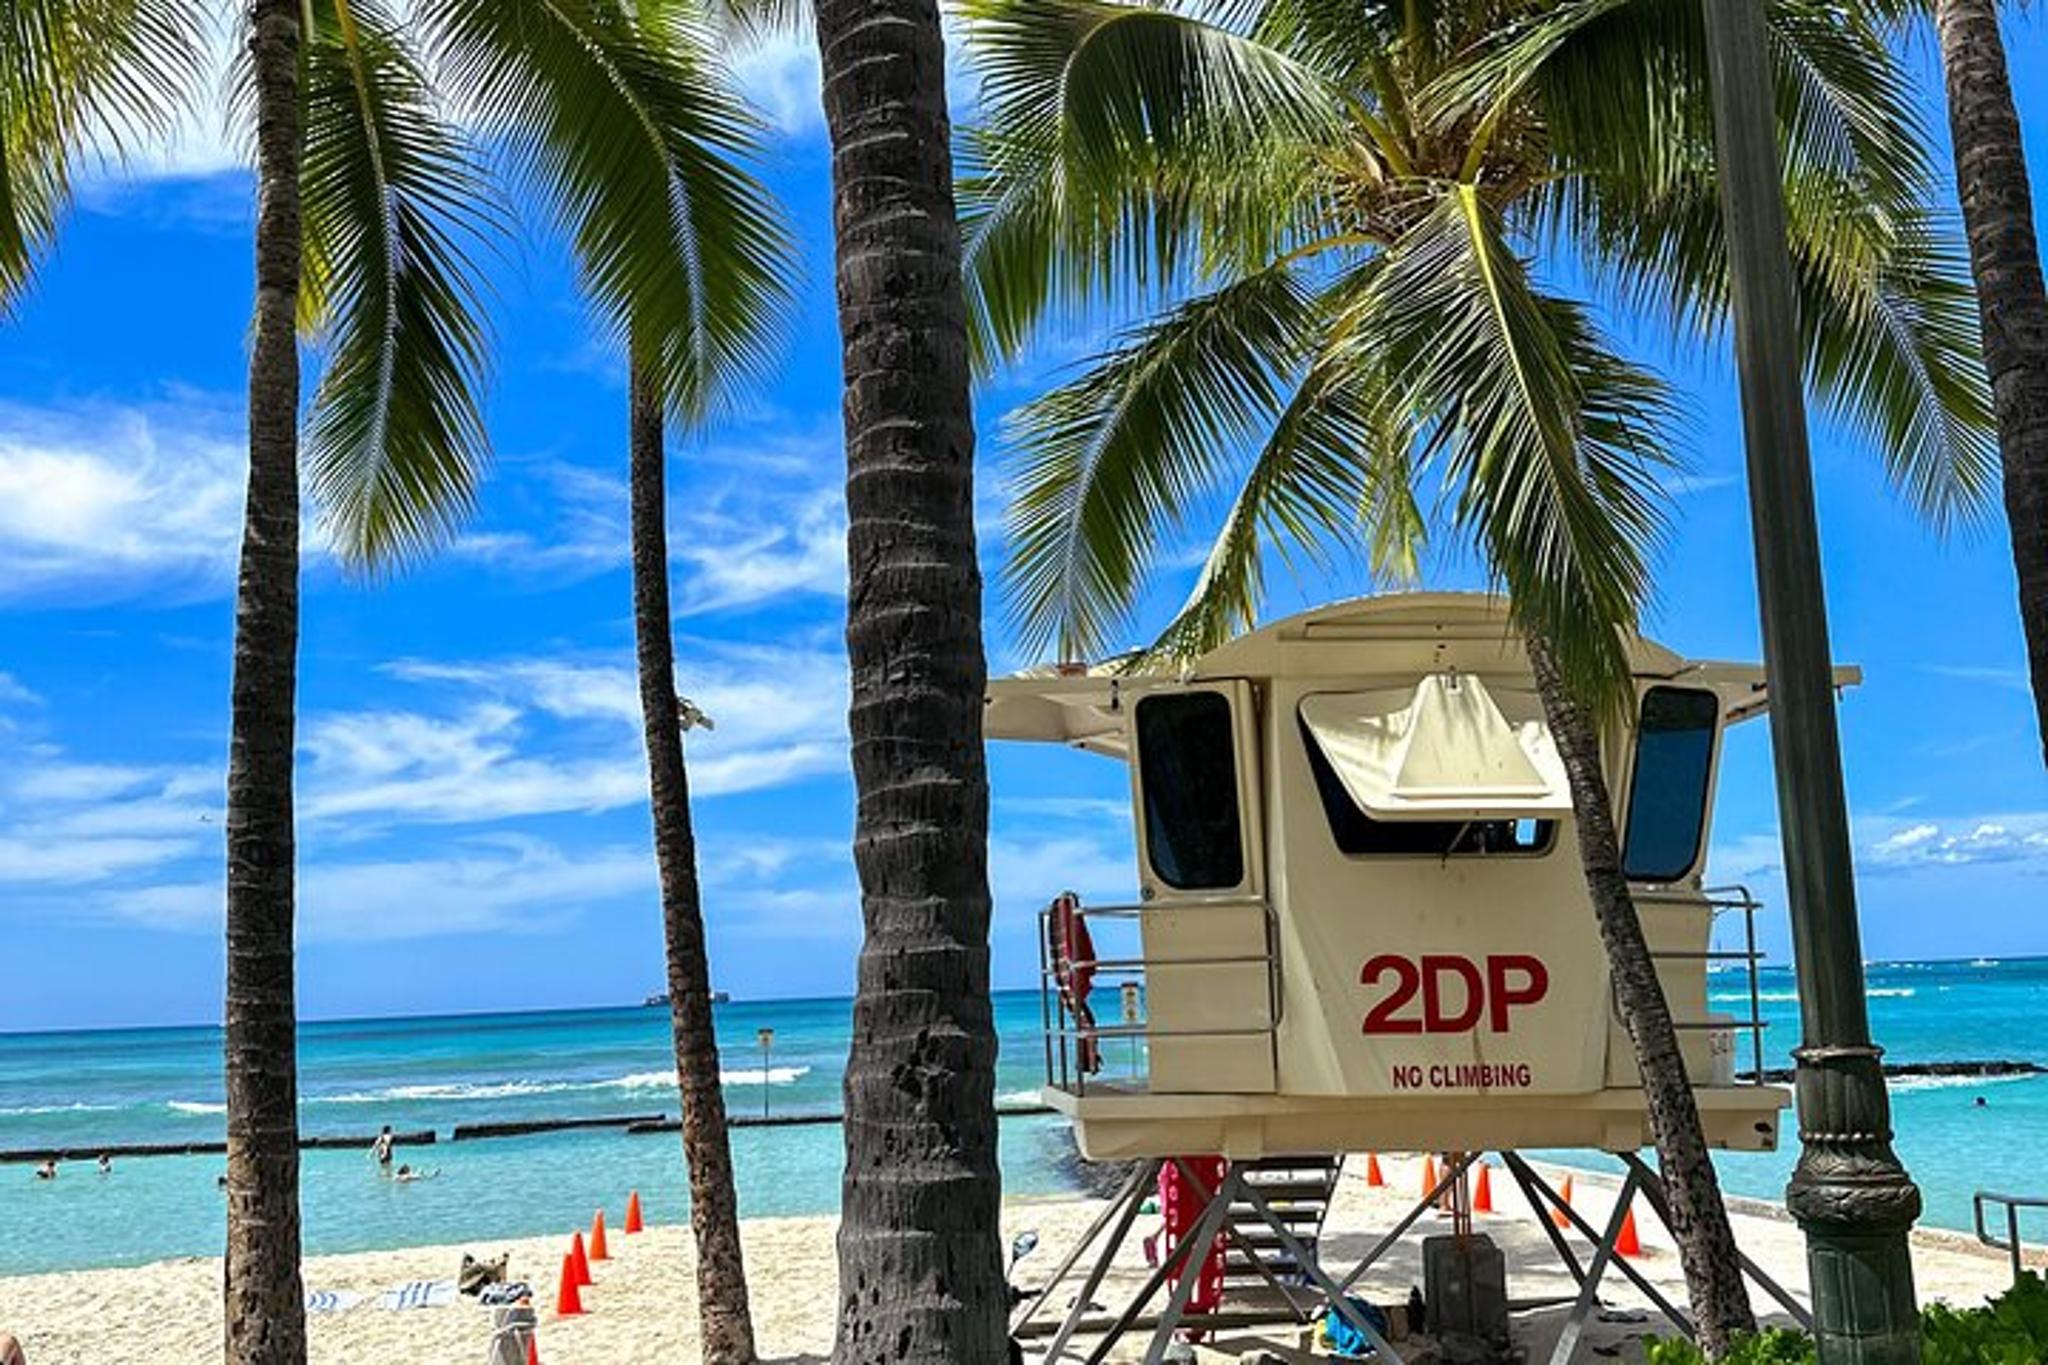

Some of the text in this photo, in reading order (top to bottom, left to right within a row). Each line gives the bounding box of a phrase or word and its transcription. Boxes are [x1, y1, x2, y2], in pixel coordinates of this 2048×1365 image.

[1360, 954, 1549, 1034] 2DP
[1393, 1064, 1532, 1089] NO CLIMBING
